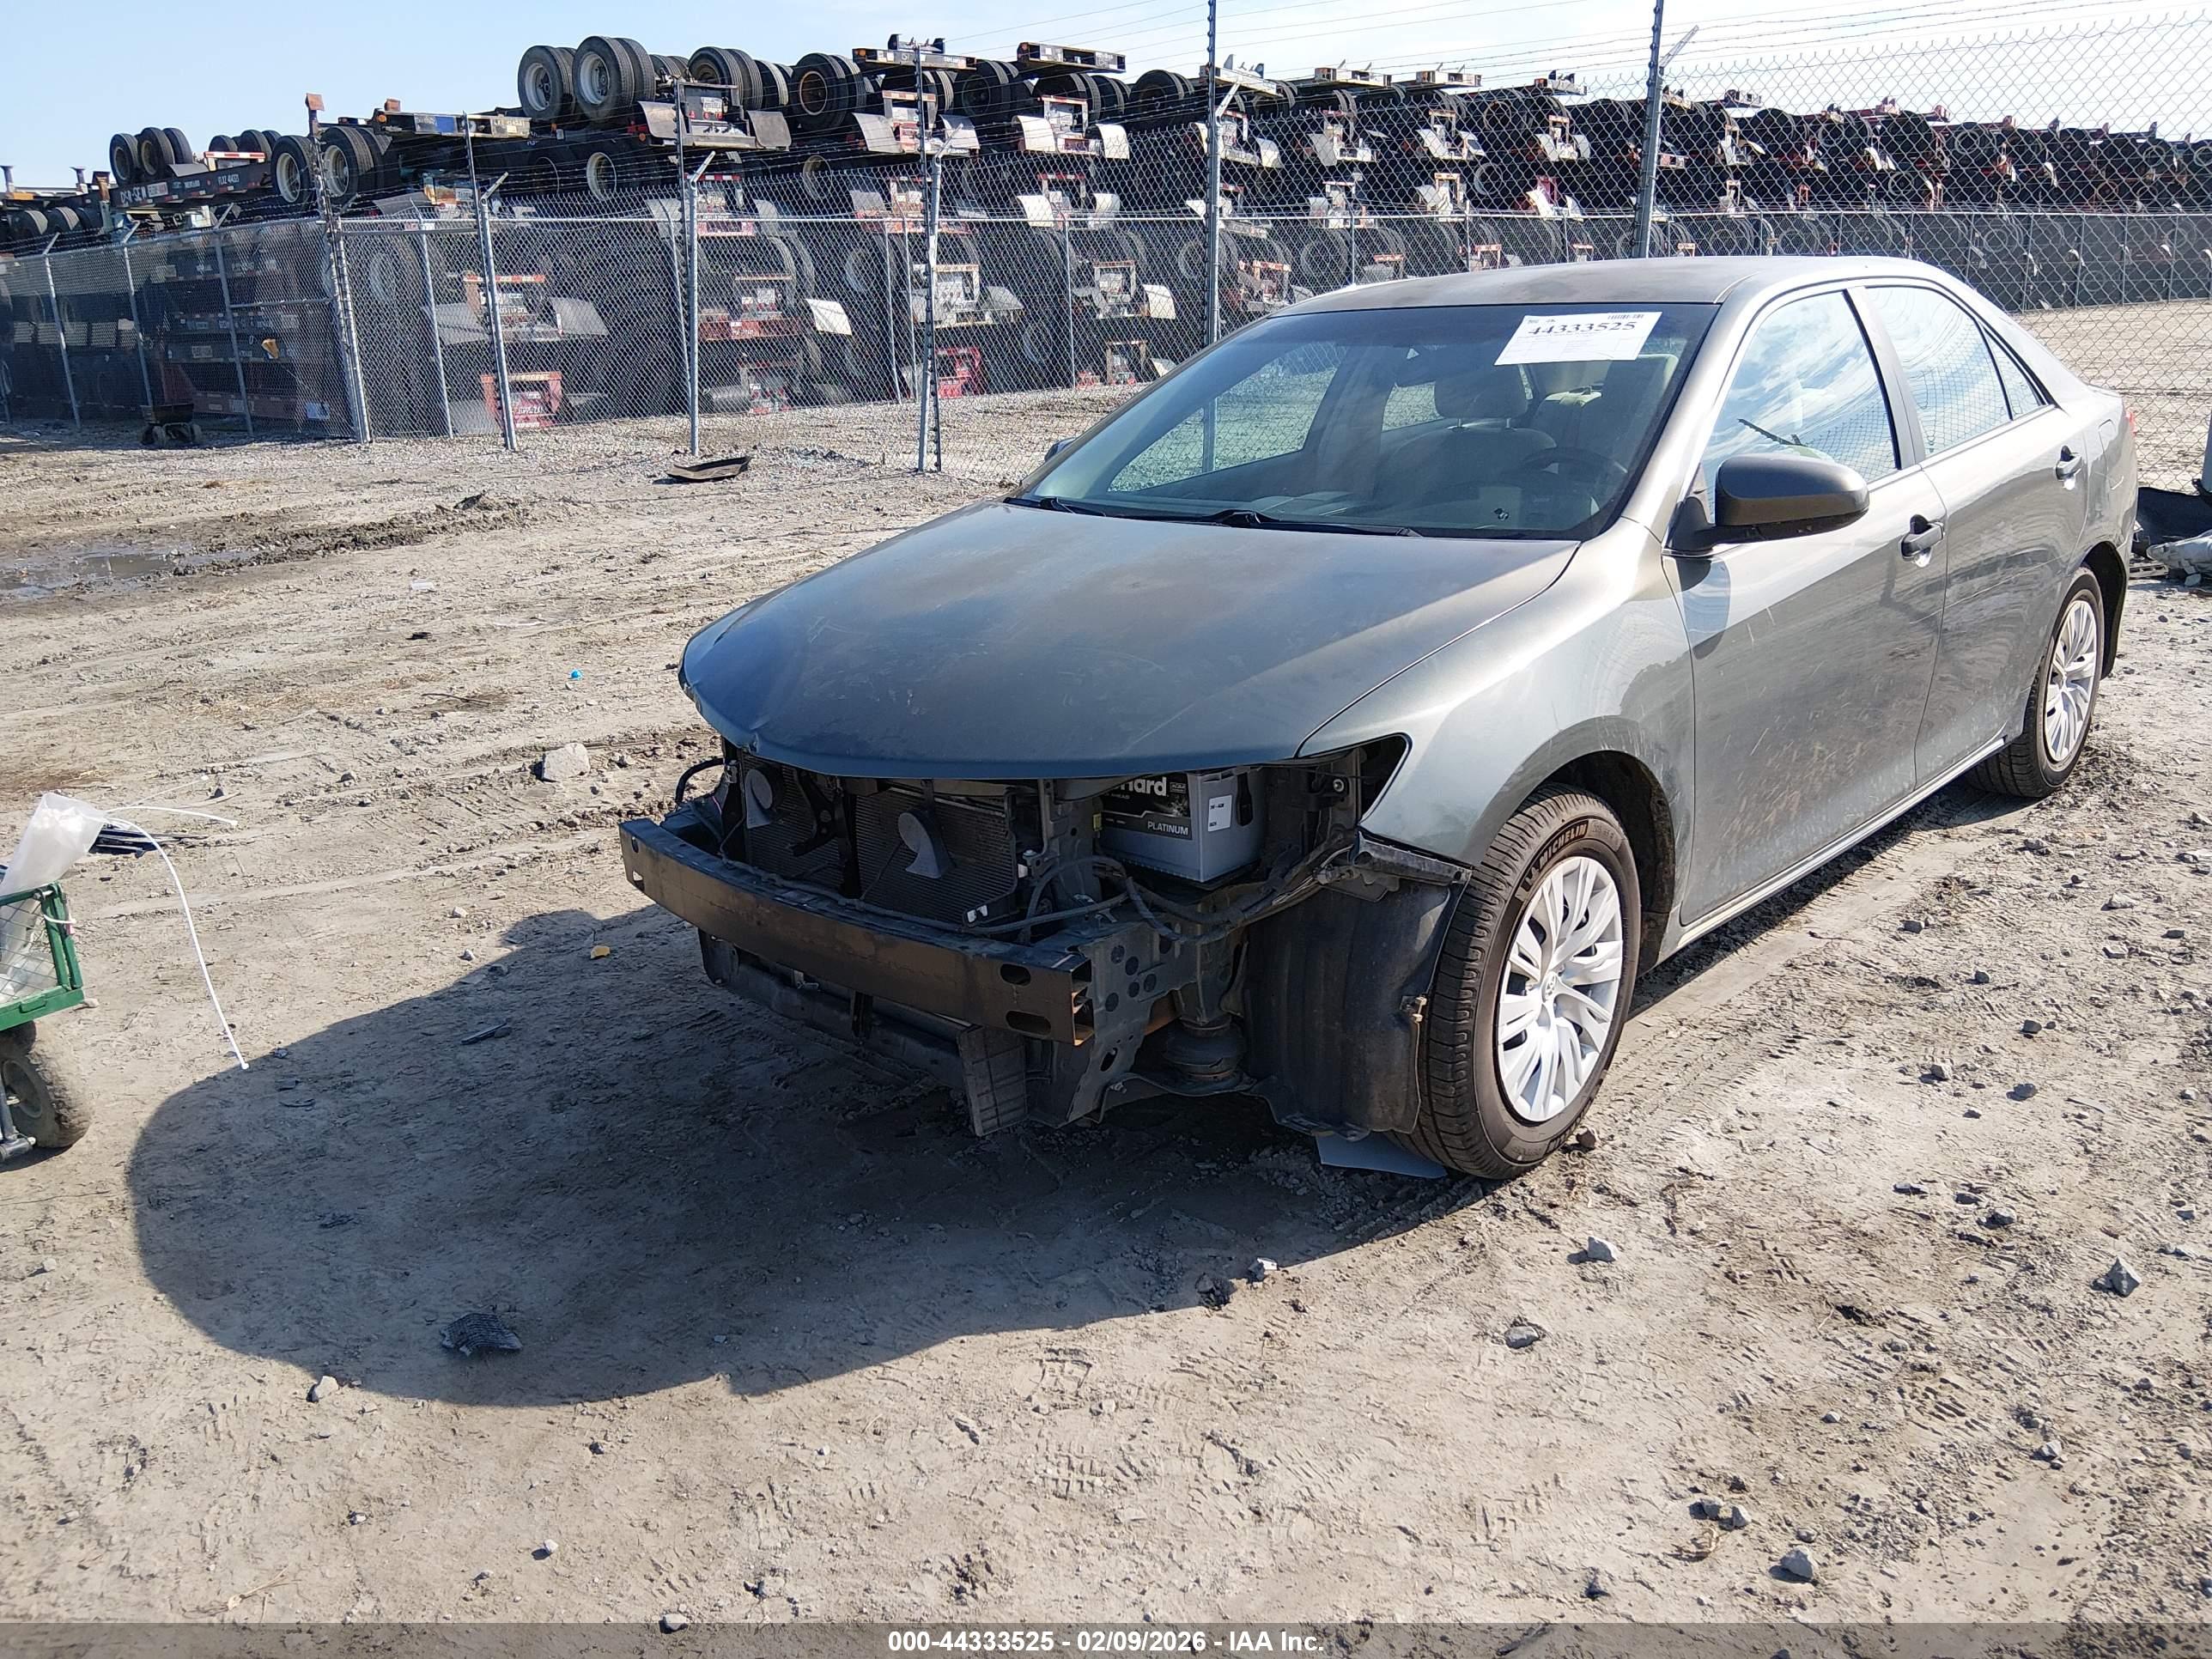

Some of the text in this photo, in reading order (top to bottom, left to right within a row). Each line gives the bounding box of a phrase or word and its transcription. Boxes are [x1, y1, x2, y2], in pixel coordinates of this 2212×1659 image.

[1528, 322, 1638, 335] 44333525
[1147, 821, 1188, 836] PLATINUM
[1539, 823, 1587, 868] MICHELIN
